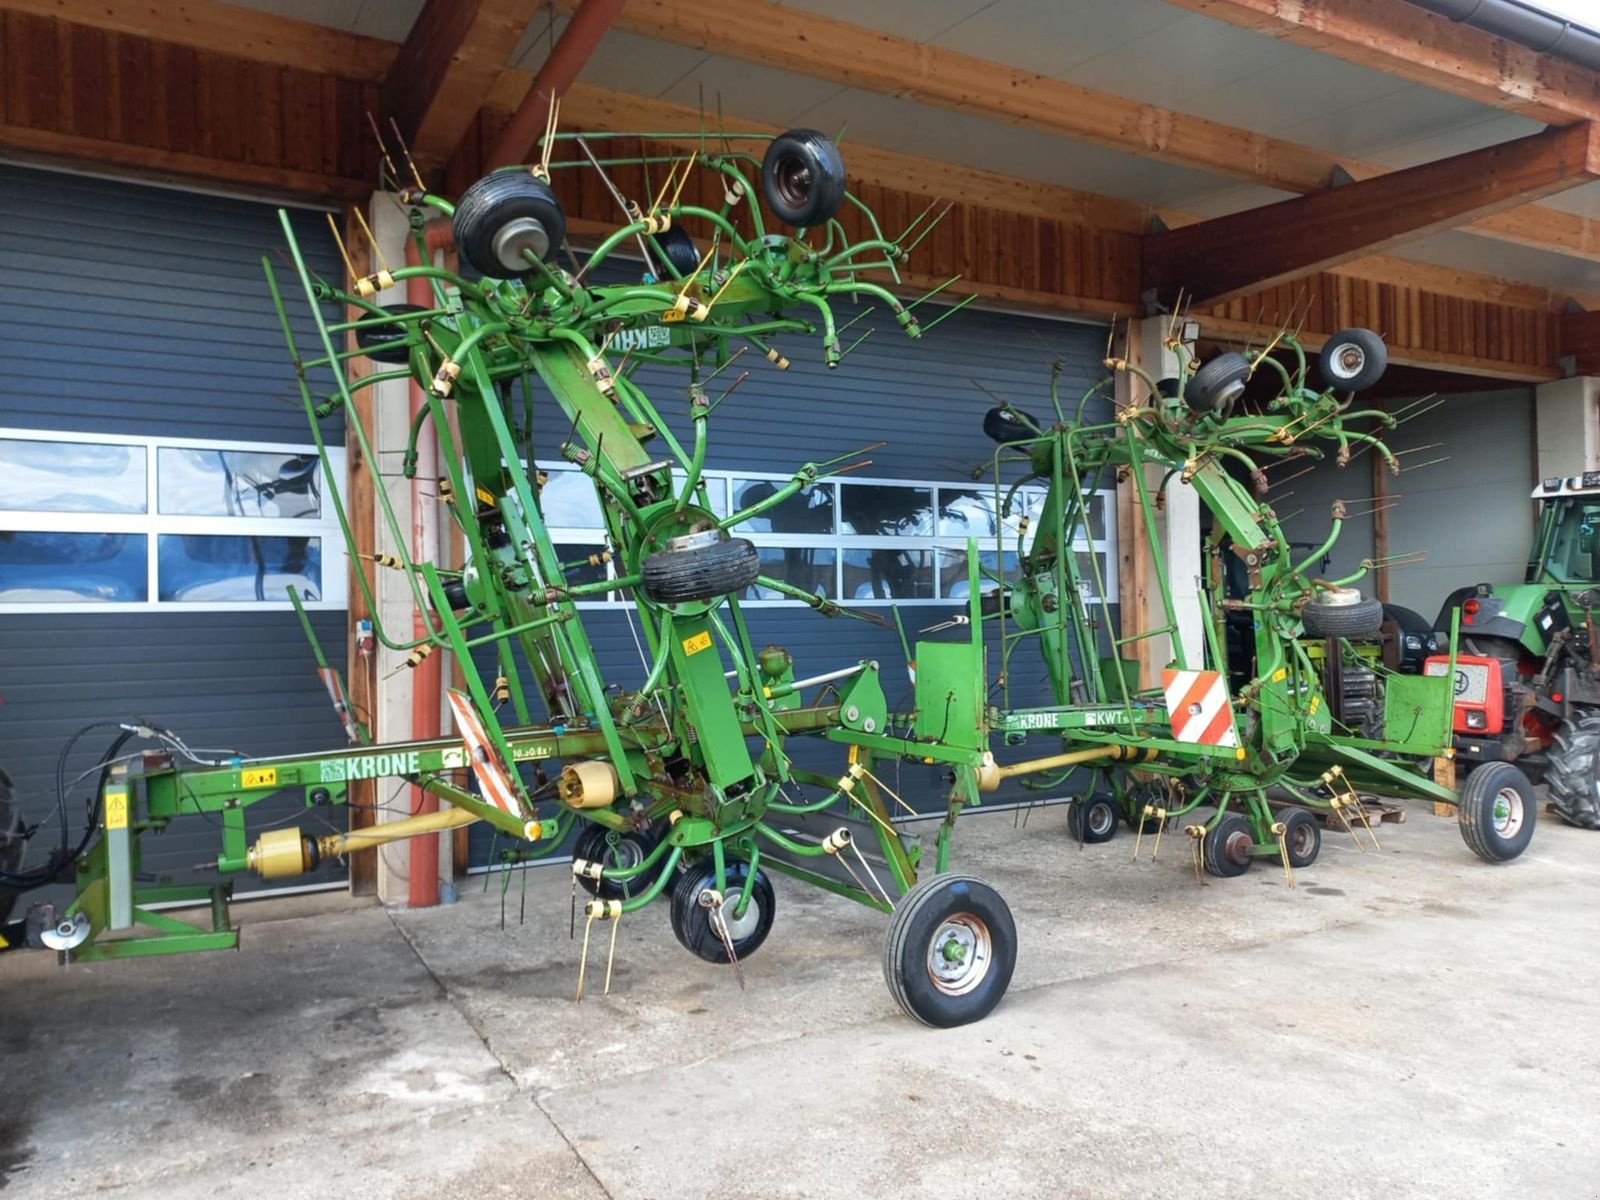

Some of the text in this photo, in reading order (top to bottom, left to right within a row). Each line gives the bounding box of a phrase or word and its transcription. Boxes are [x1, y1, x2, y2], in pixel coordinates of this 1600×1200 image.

[1020, 712, 1059, 729] KRONE
[1097, 711, 1123, 726] KWT
[346, 751, 420, 777] KRONE
